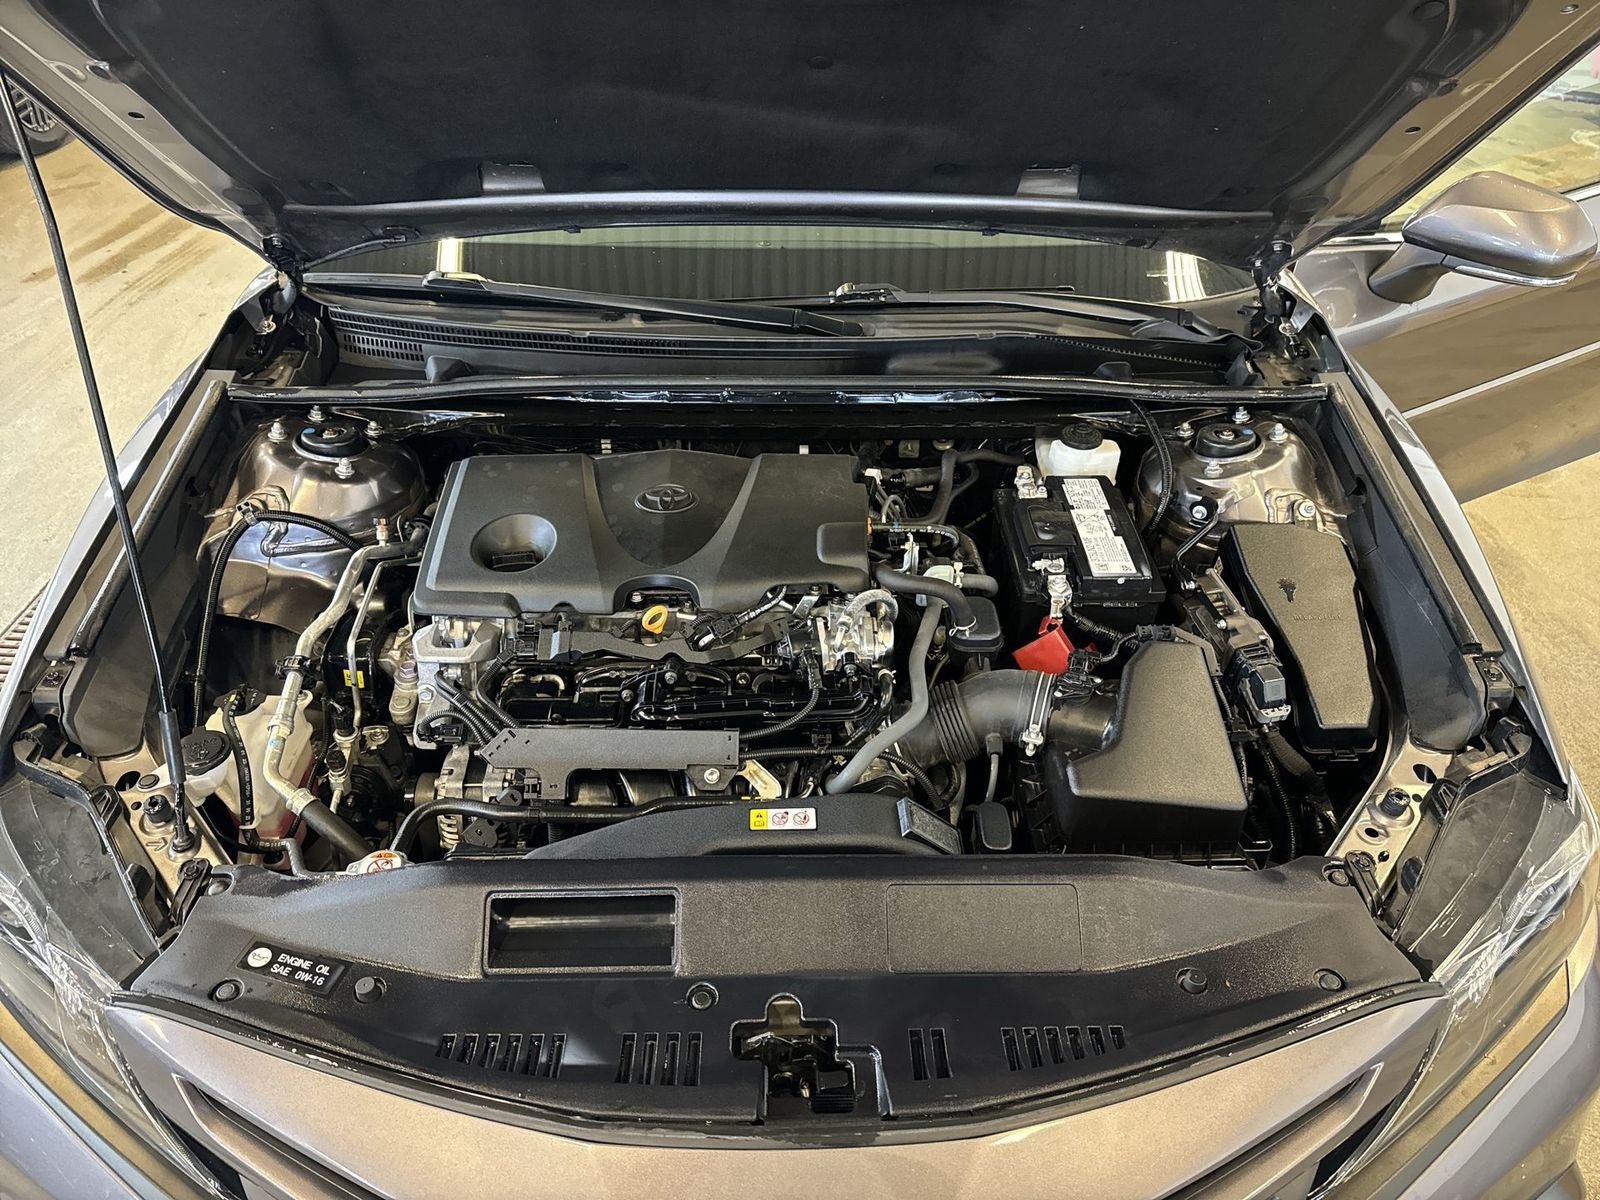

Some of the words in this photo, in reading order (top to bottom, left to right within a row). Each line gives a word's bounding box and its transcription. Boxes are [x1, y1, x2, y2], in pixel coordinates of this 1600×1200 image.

[270, 963, 292, 977] SAE
[294, 970, 325, 986] 0W-16
[277, 953, 313, 970] ENGINE
[315, 964, 331, 976] OIL
